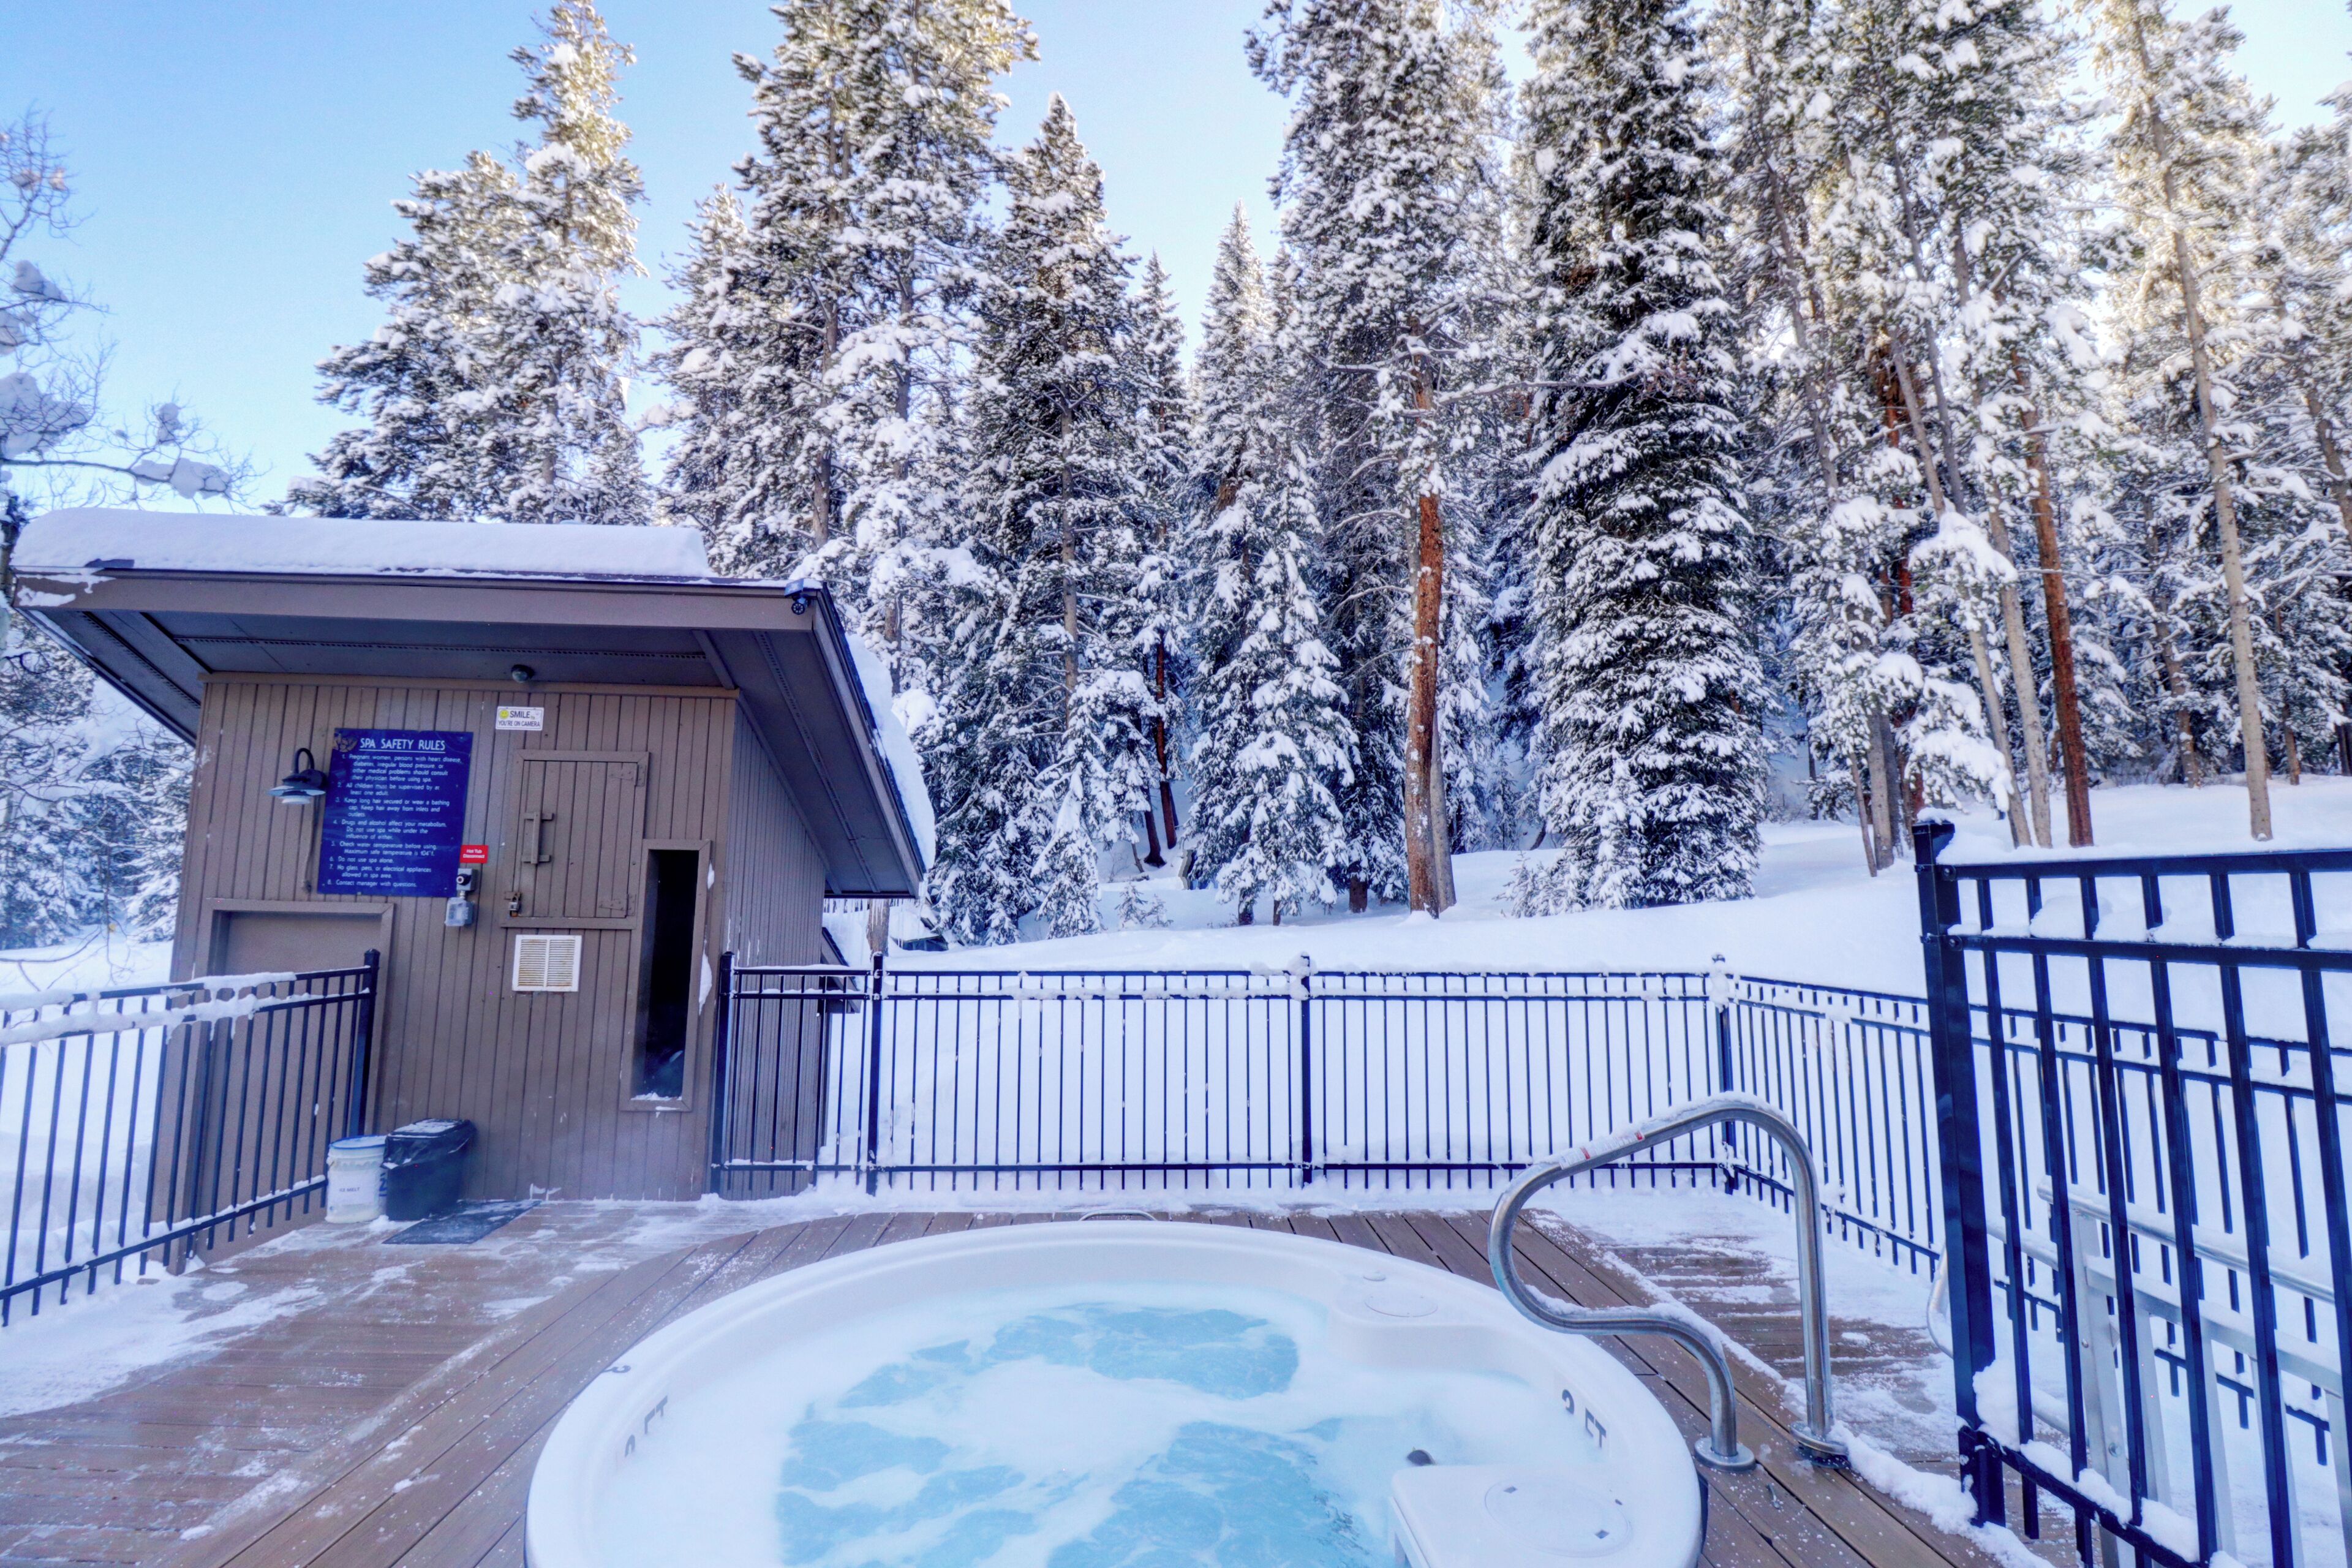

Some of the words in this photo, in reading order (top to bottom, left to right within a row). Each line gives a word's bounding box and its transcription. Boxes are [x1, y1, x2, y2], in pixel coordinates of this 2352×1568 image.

[360, 738, 376, 748] SPA
[381, 739, 414, 749] SAFETY
[418, 740, 445, 750] RULES
